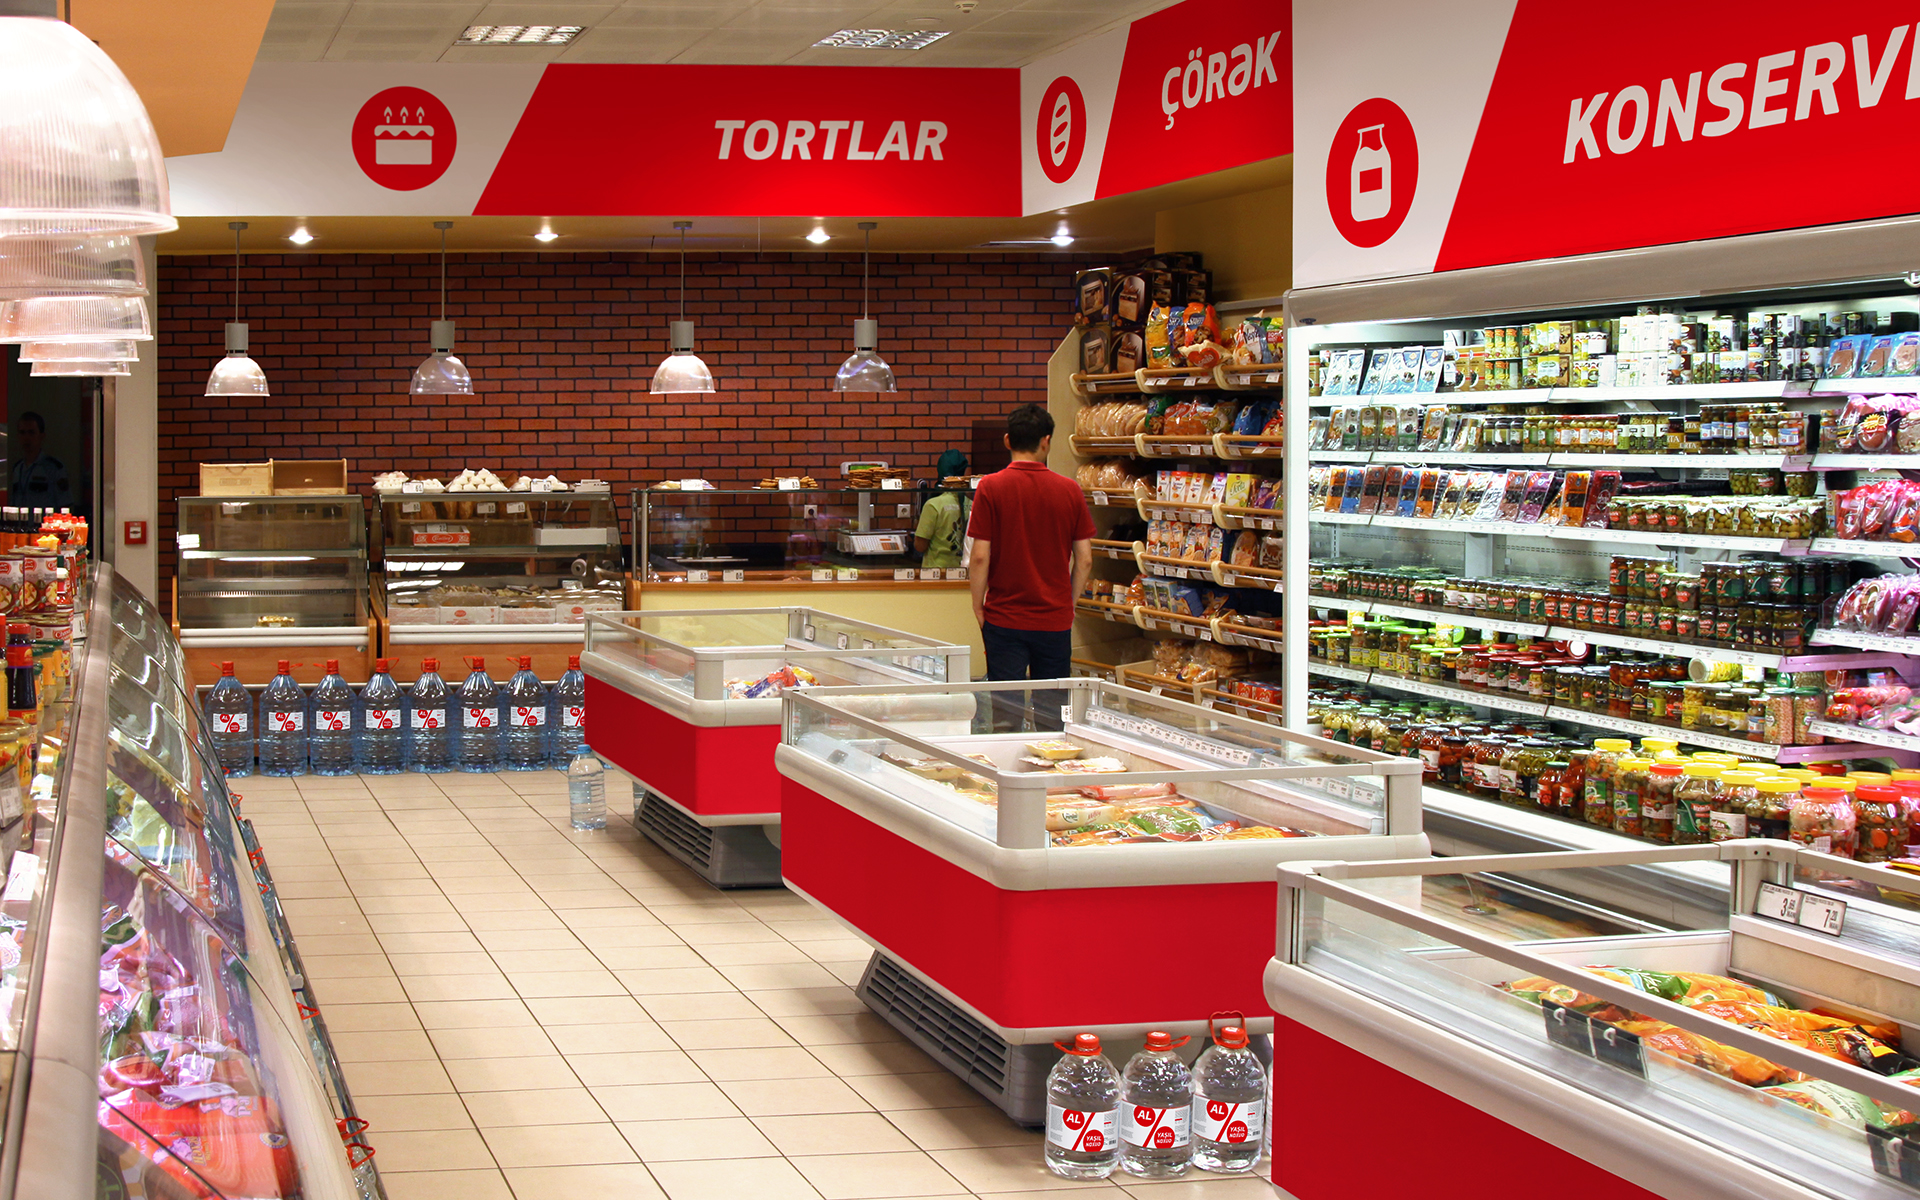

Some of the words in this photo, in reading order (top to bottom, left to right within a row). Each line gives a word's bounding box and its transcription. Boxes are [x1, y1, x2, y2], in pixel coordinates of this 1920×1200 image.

[1161, 31, 1281, 130] ÇÖRƏK
[714, 120, 948, 161] TORTLAR
[1780, 897, 1788, 917] 3
[1824, 909, 1831, 928] 7
[1137, 1109, 1152, 1120] AL
[1210, 1104, 1225, 1115] AL
[1066, 1114, 1081, 1124] AL
[1156, 1131, 1173, 1139] YAŞIL
[1230, 1126, 1246, 1134] YAŞIL
